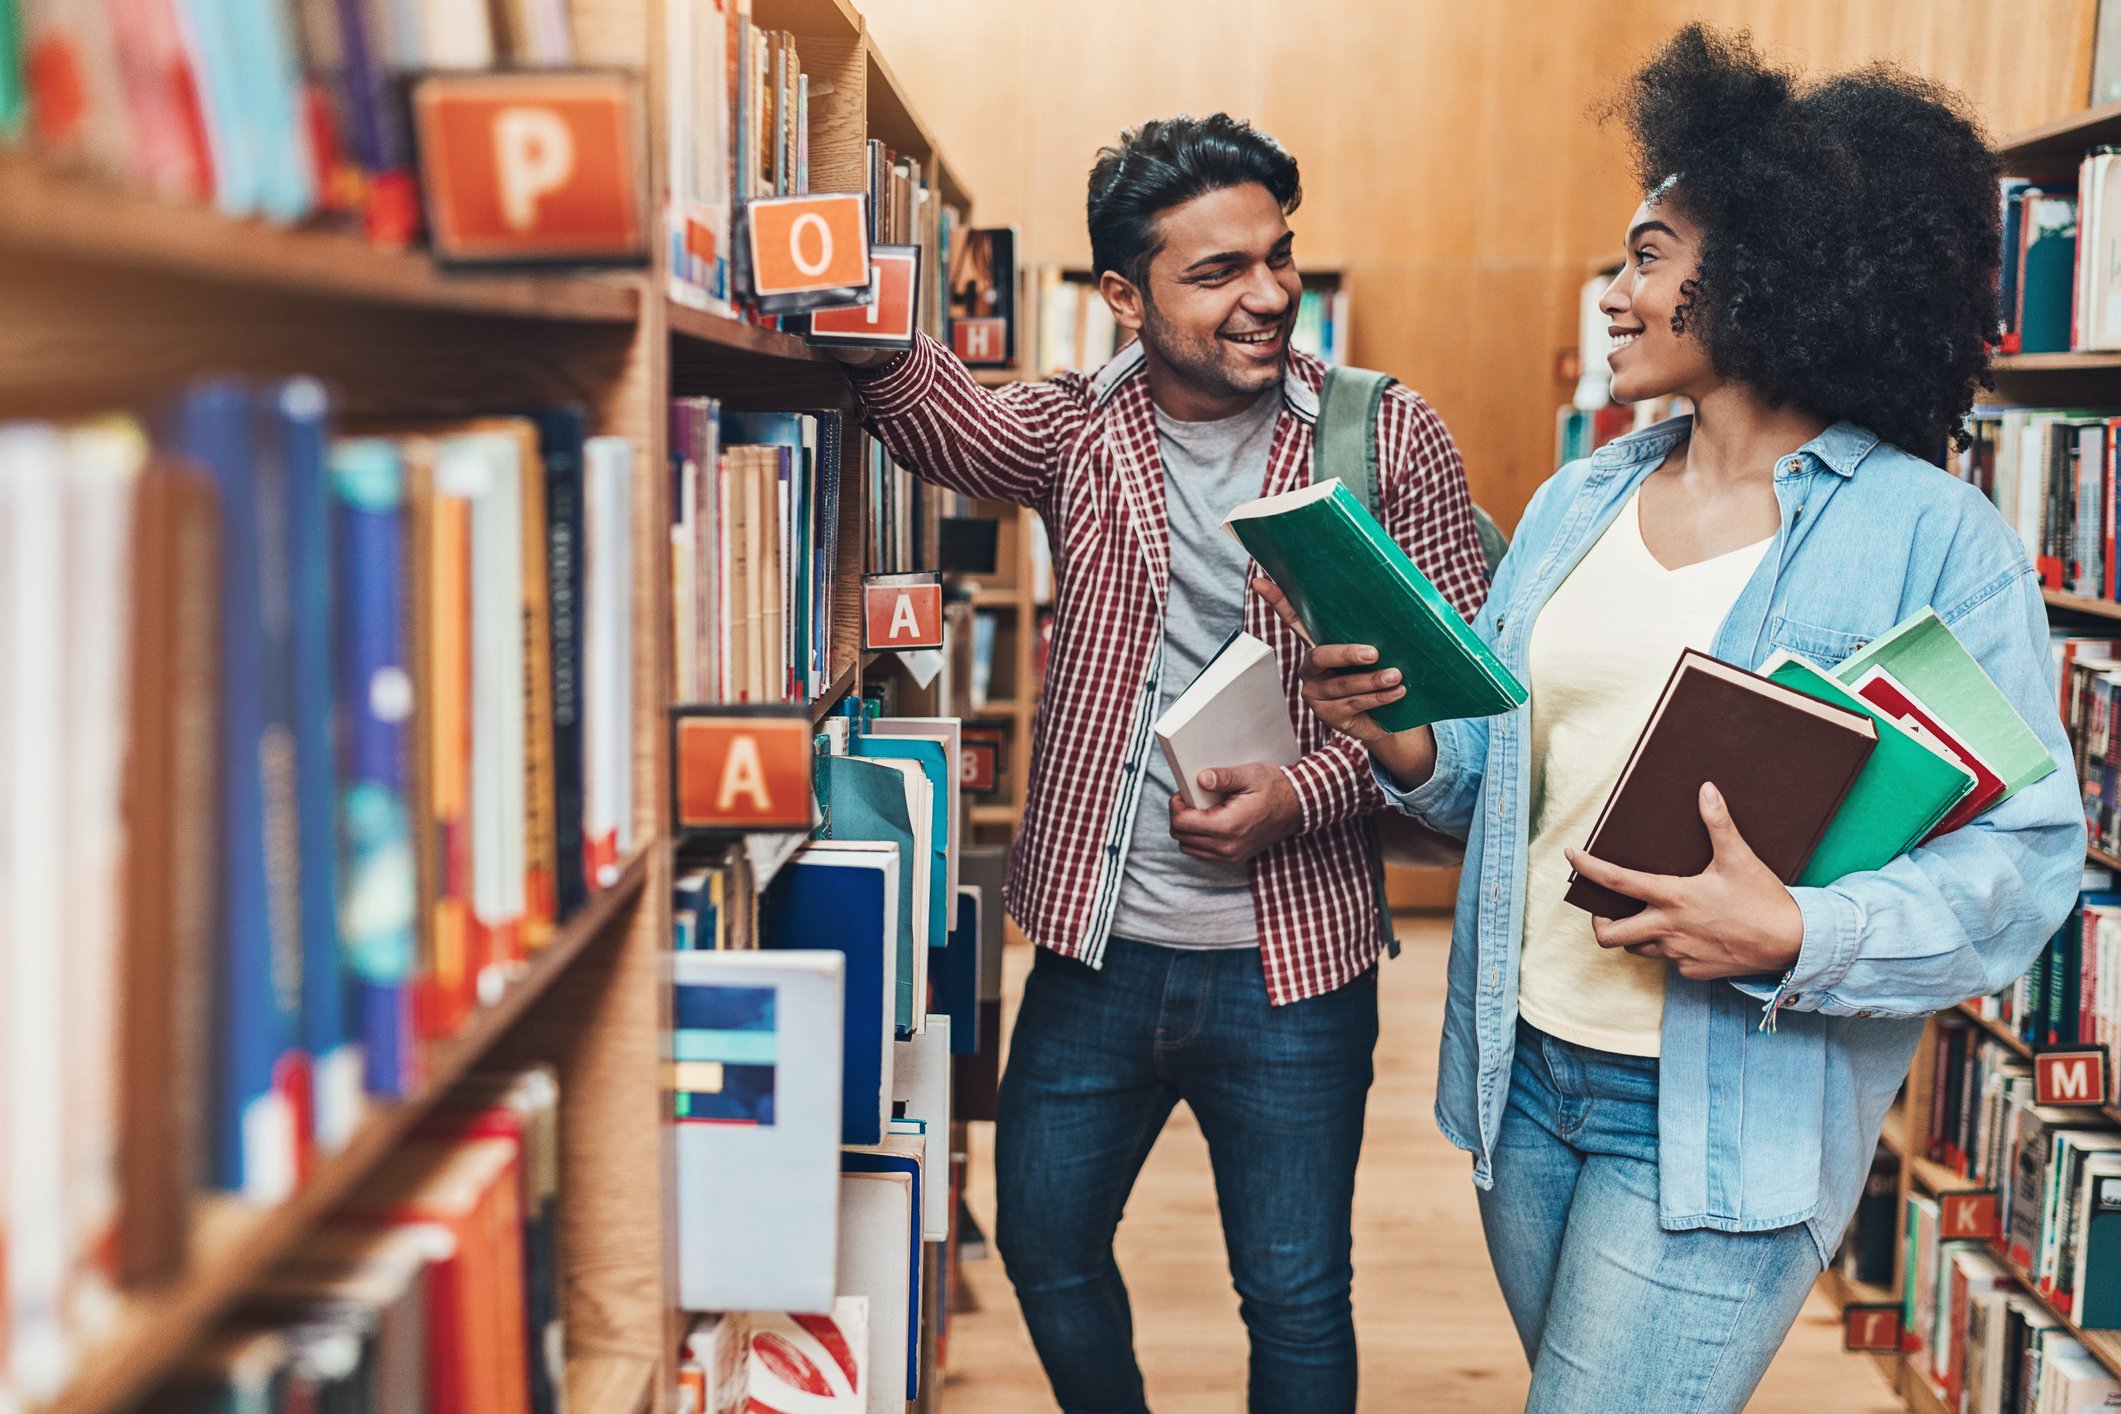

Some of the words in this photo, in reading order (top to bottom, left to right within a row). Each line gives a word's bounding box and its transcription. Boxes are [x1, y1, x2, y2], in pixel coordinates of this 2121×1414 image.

[493, 106, 574, 231] P
[790, 213, 833, 277] O
[967, 326, 989, 356] H
[889, 594, 920, 638] A
[718, 736, 772, 811] A
[2051, 1060, 2087, 1099] M
[1957, 1199, 1979, 1232] K
